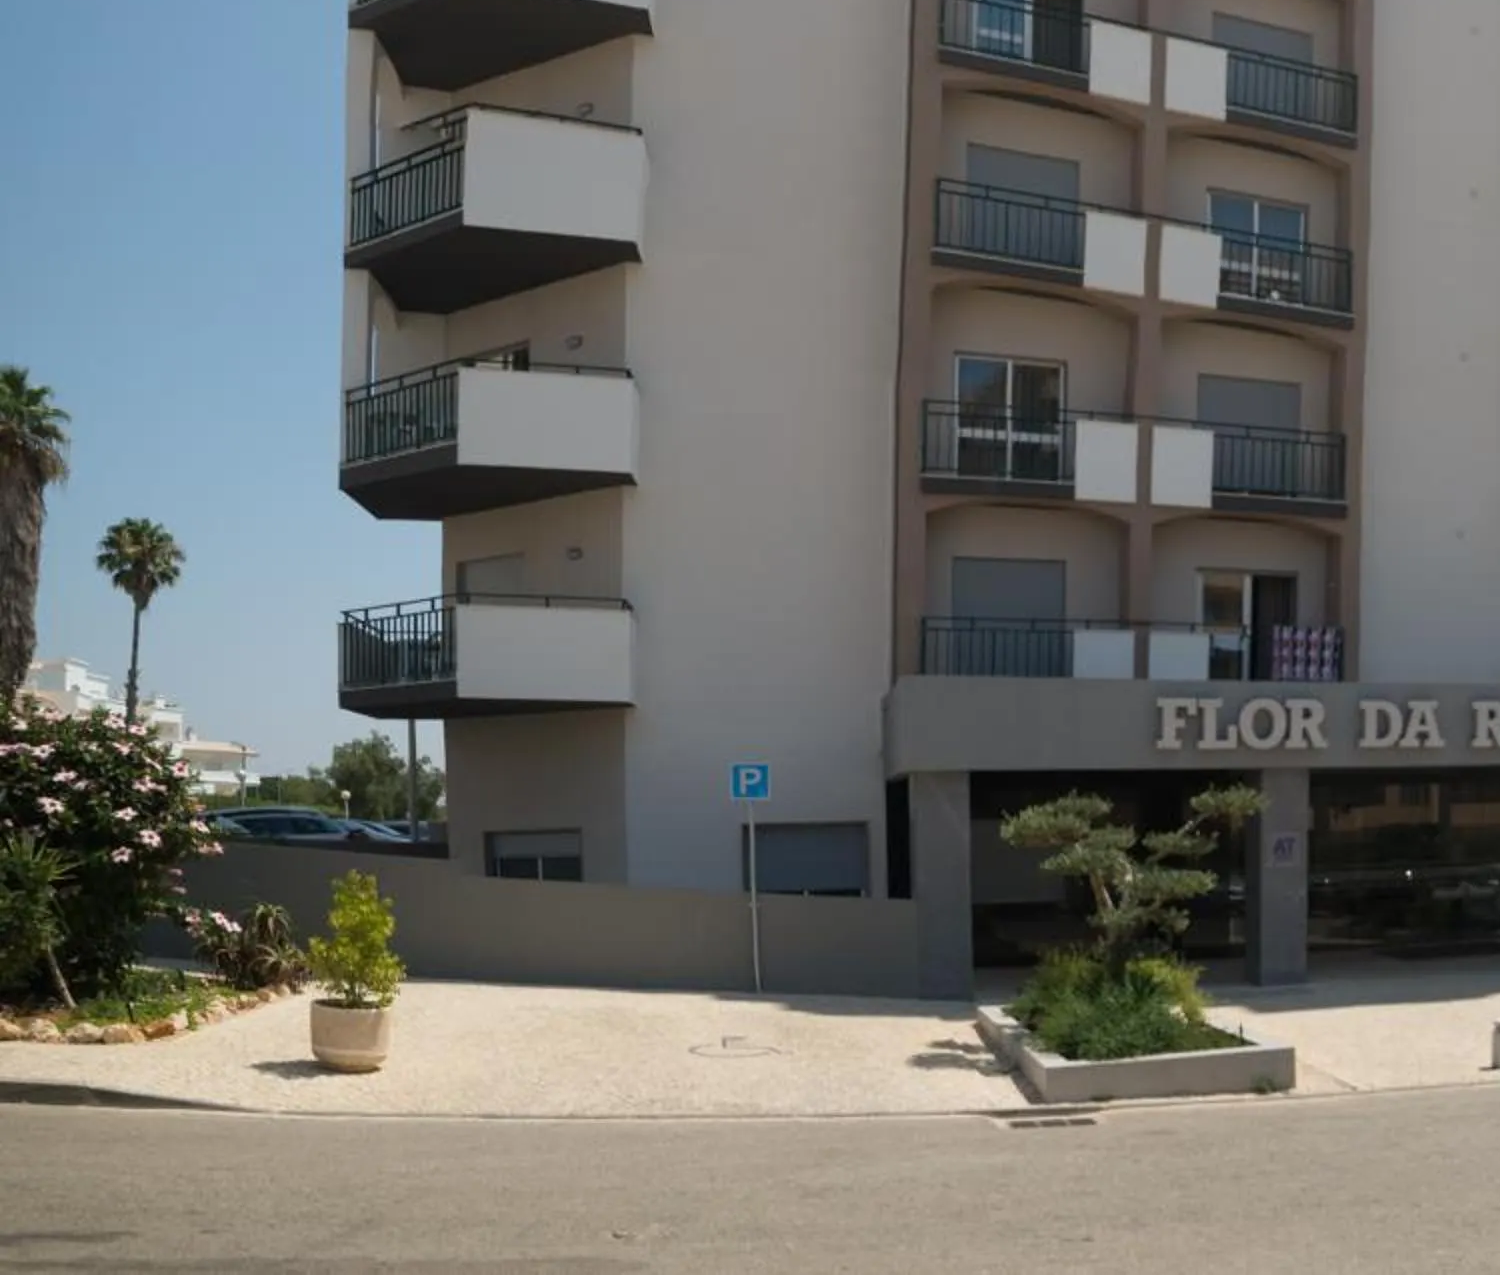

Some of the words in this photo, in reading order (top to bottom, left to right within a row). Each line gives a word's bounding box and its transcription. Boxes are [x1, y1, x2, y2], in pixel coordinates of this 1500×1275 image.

[1156, 697, 1327, 750] FLOR
[1358, 700, 1444, 748] DA
[740, 769, 761, 794] P
